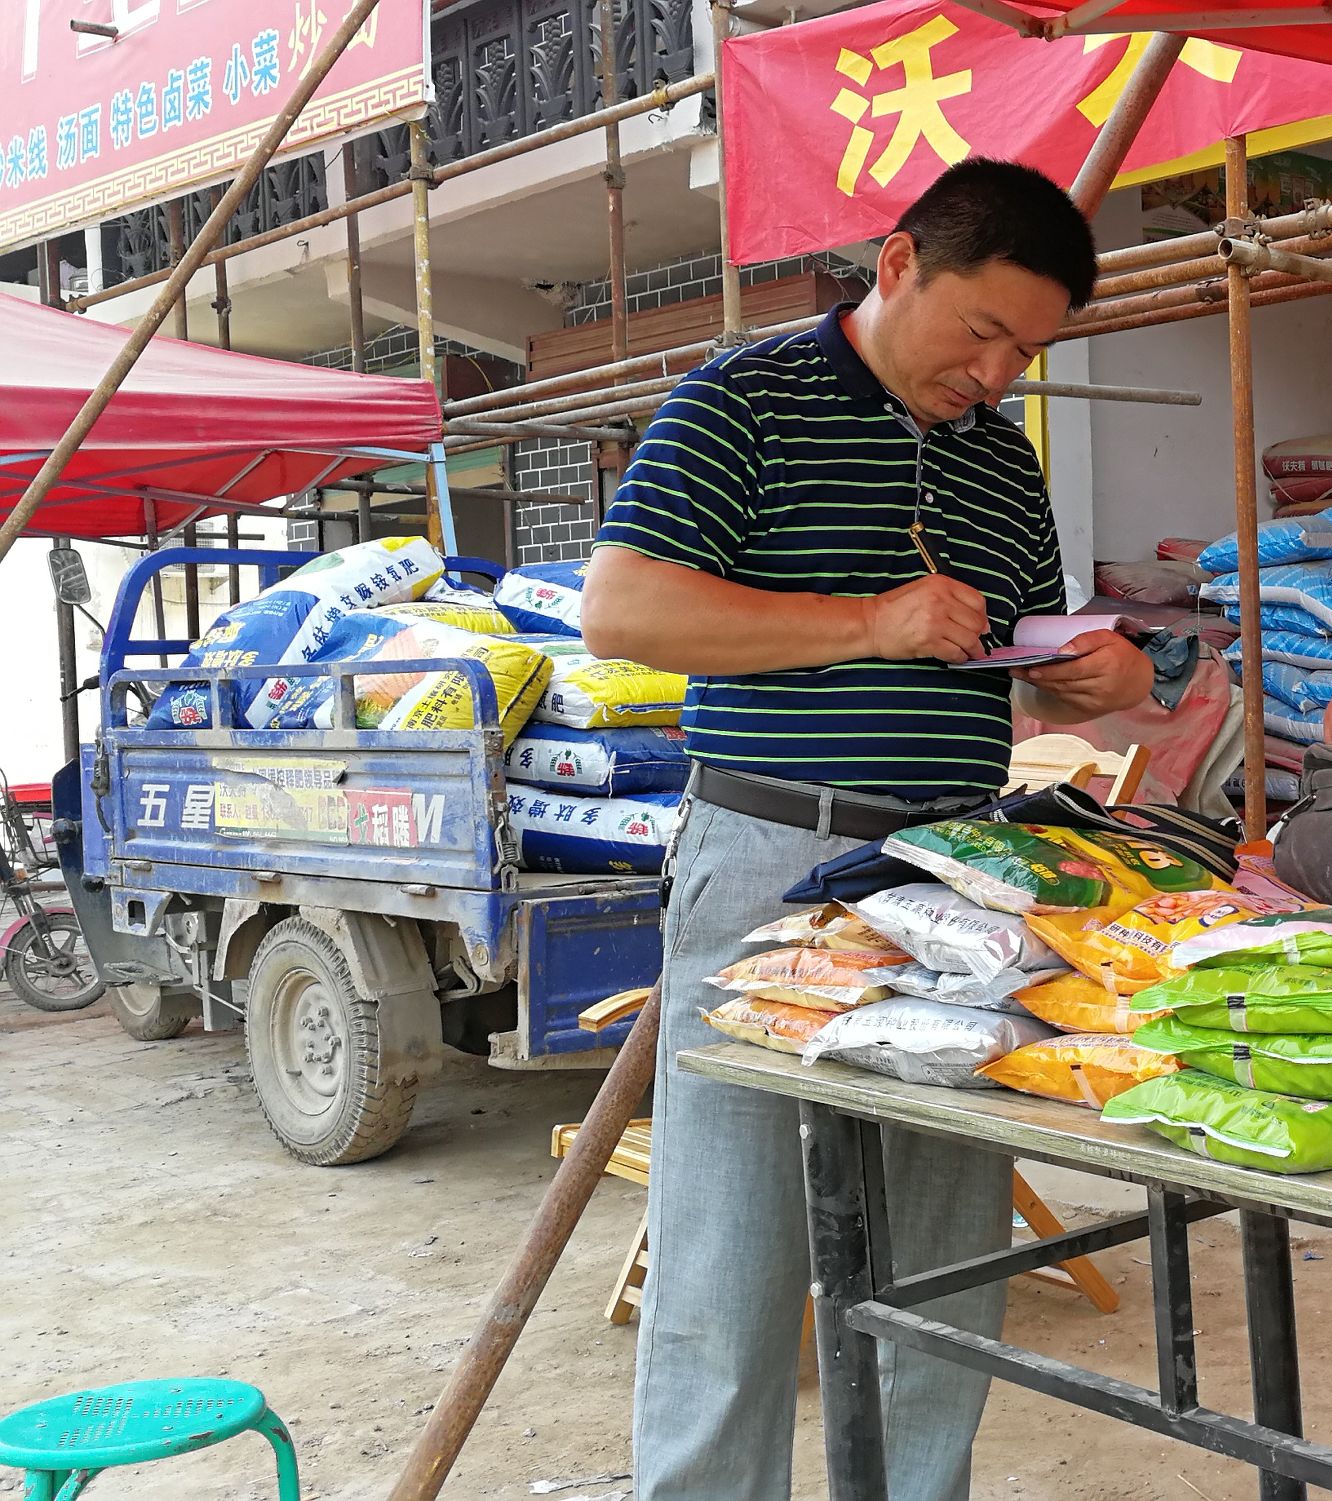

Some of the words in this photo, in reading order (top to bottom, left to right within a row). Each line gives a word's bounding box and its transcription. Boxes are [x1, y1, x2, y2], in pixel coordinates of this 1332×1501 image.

[56, 108, 101, 166] 汤面
[111, 58, 212, 148] 特色卤菜
[223, 29, 280, 101] 小菜
[136, 784, 214, 829] 五星
[507, 795, 601, 826] 多肽增效
